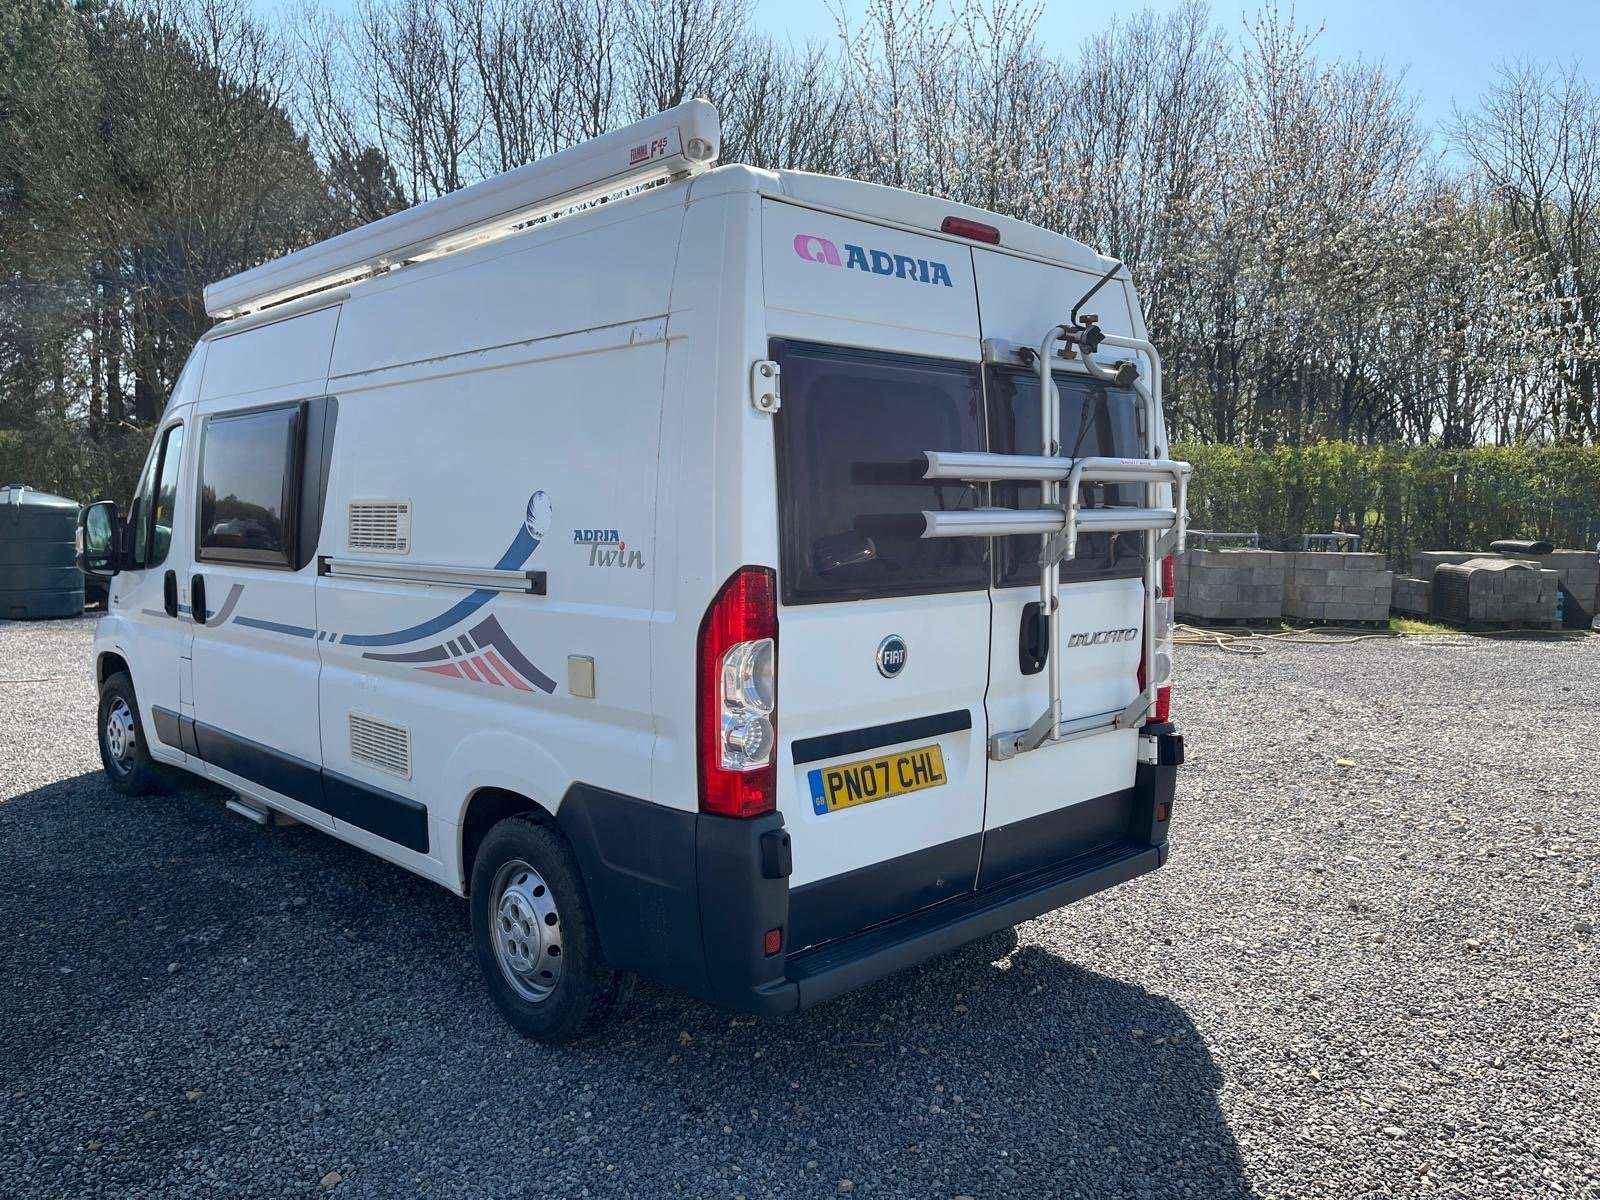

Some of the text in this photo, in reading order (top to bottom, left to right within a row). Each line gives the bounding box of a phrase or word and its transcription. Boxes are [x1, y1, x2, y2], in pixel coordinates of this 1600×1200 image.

[844, 243, 953, 288] ADRIA
[573, 529, 620, 542] ADRIA
[575, 541, 646, 569] Twin
[1068, 627, 1139, 648] DUCATO
[883, 649, 904, 665] FIAT
[827, 752, 943, 806] PN07 CHL
